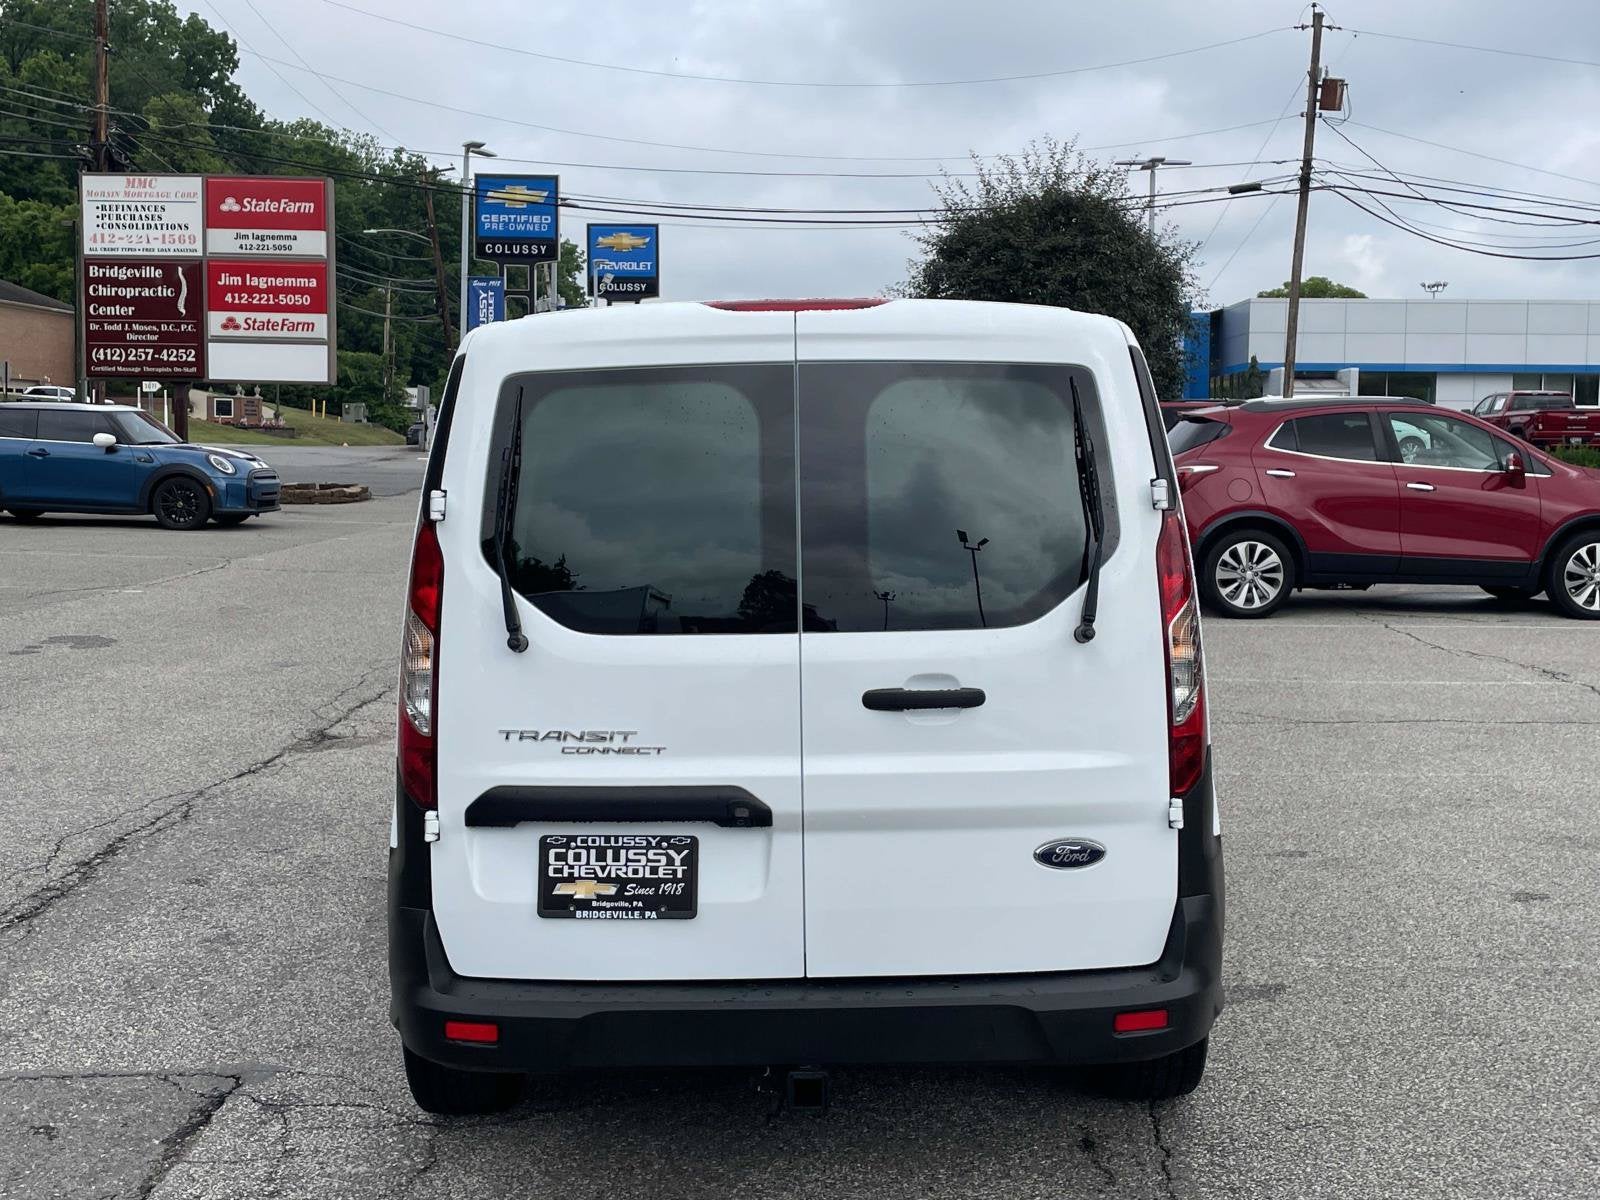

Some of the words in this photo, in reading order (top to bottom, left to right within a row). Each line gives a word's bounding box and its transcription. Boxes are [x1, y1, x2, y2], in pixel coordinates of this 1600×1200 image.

[125, 177, 157, 189] MMC
[123, 190, 171, 199] MORTGAGE
[101, 204, 166, 213] REFINANCES
[101, 213, 163, 221] PURCHASES
[481, 214, 552, 223] CERTIFIED
[101, 222, 190, 231] CONSOLIDATIONS
[484, 223, 548, 232] PRE-OWNED
[234, 232, 250, 241] Jim
[252, 233, 298, 242] Iagnemma
[239, 243, 293, 252] 412-221-5050
[485, 243, 548, 255] COLUSSY
[596, 261, 653, 270] HEVROLET
[89, 265, 163, 280] Bridgeville
[217, 273, 242, 286] Jim
[246, 274, 317, 289] Iagnemma
[88, 284, 175, 299] Chiropractic
[224, 293, 311, 305] 412-221-5050
[89, 303, 135, 316] Center
[90, 322, 102, 331] Dr.
[104, 322, 122, 331] Todd
[124, 323, 130, 331] J.
[132, 323, 160, 332] Moses,
[161, 323, 180, 333] D.C.,
[181, 324, 197, 332] P.C.
[126, 332, 160, 341] Director
[127, 348, 196, 362] 257-4252
[91, 364, 116, 372] Certified
[117, 365, 141, 373] Massage
[143, 365, 172, 373] Therapists
[498, 729, 638, 743] TRANSIT
[561, 746, 667, 755] CONNECT
[576, 836, 661, 847] COLUSSY
[548, 848, 690, 866] COLUSSY
[1052, 845, 1091, 862] Ford
[548, 865, 688, 878] CHEVROLET
[624, 883, 655, 896] Since
[658, 882, 685, 896] 1918
[591, 900, 632, 908] Bridgeville,
[645, 911, 658, 919] PA
